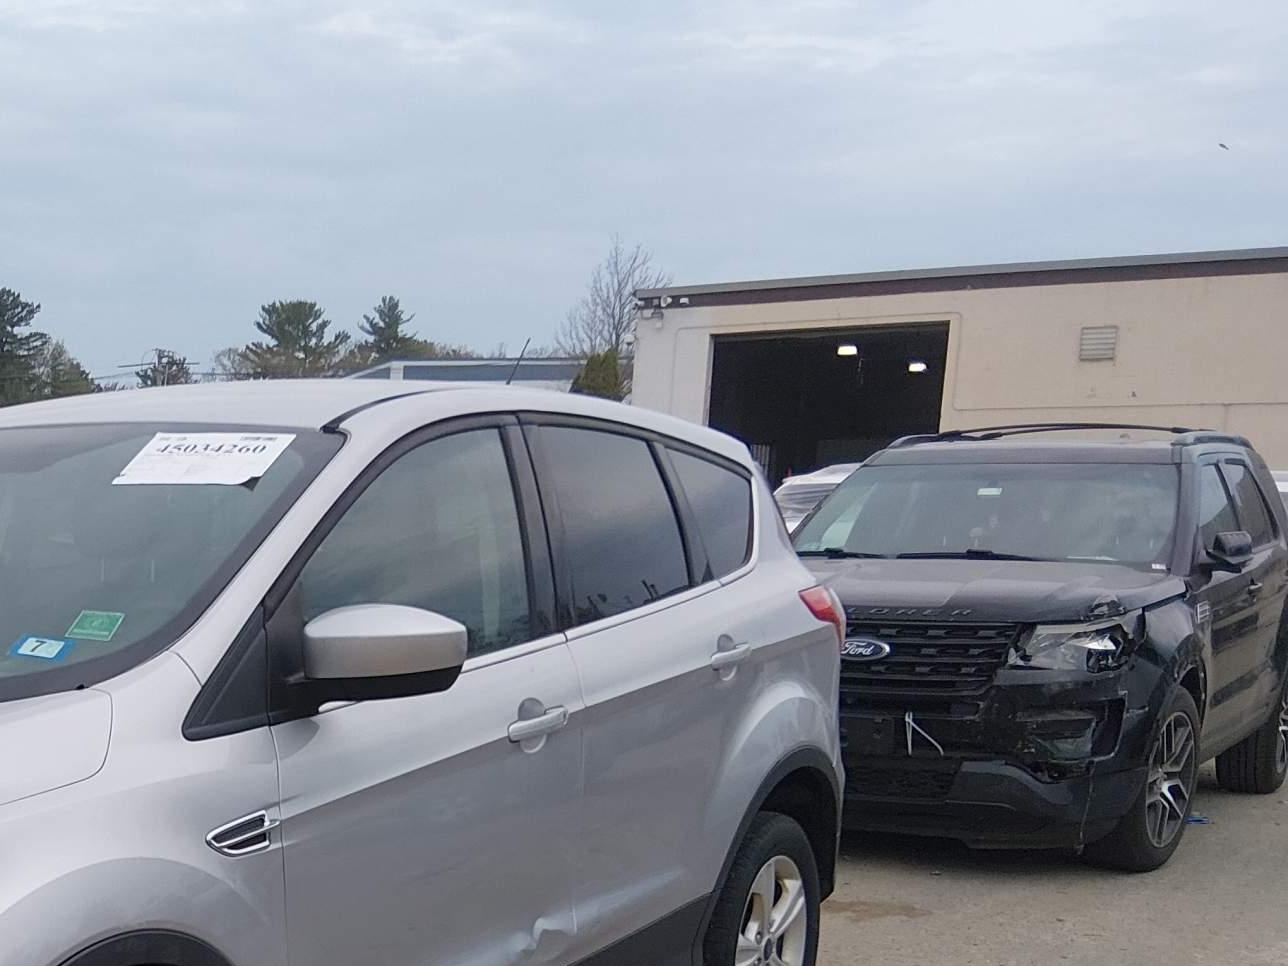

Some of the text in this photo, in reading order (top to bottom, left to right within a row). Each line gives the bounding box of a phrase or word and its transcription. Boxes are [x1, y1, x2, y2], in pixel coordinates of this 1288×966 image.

[155, 443, 267, 454] 45034260
[30, 639, 48, 653] 7
[841, 641, 875, 656] Ford
